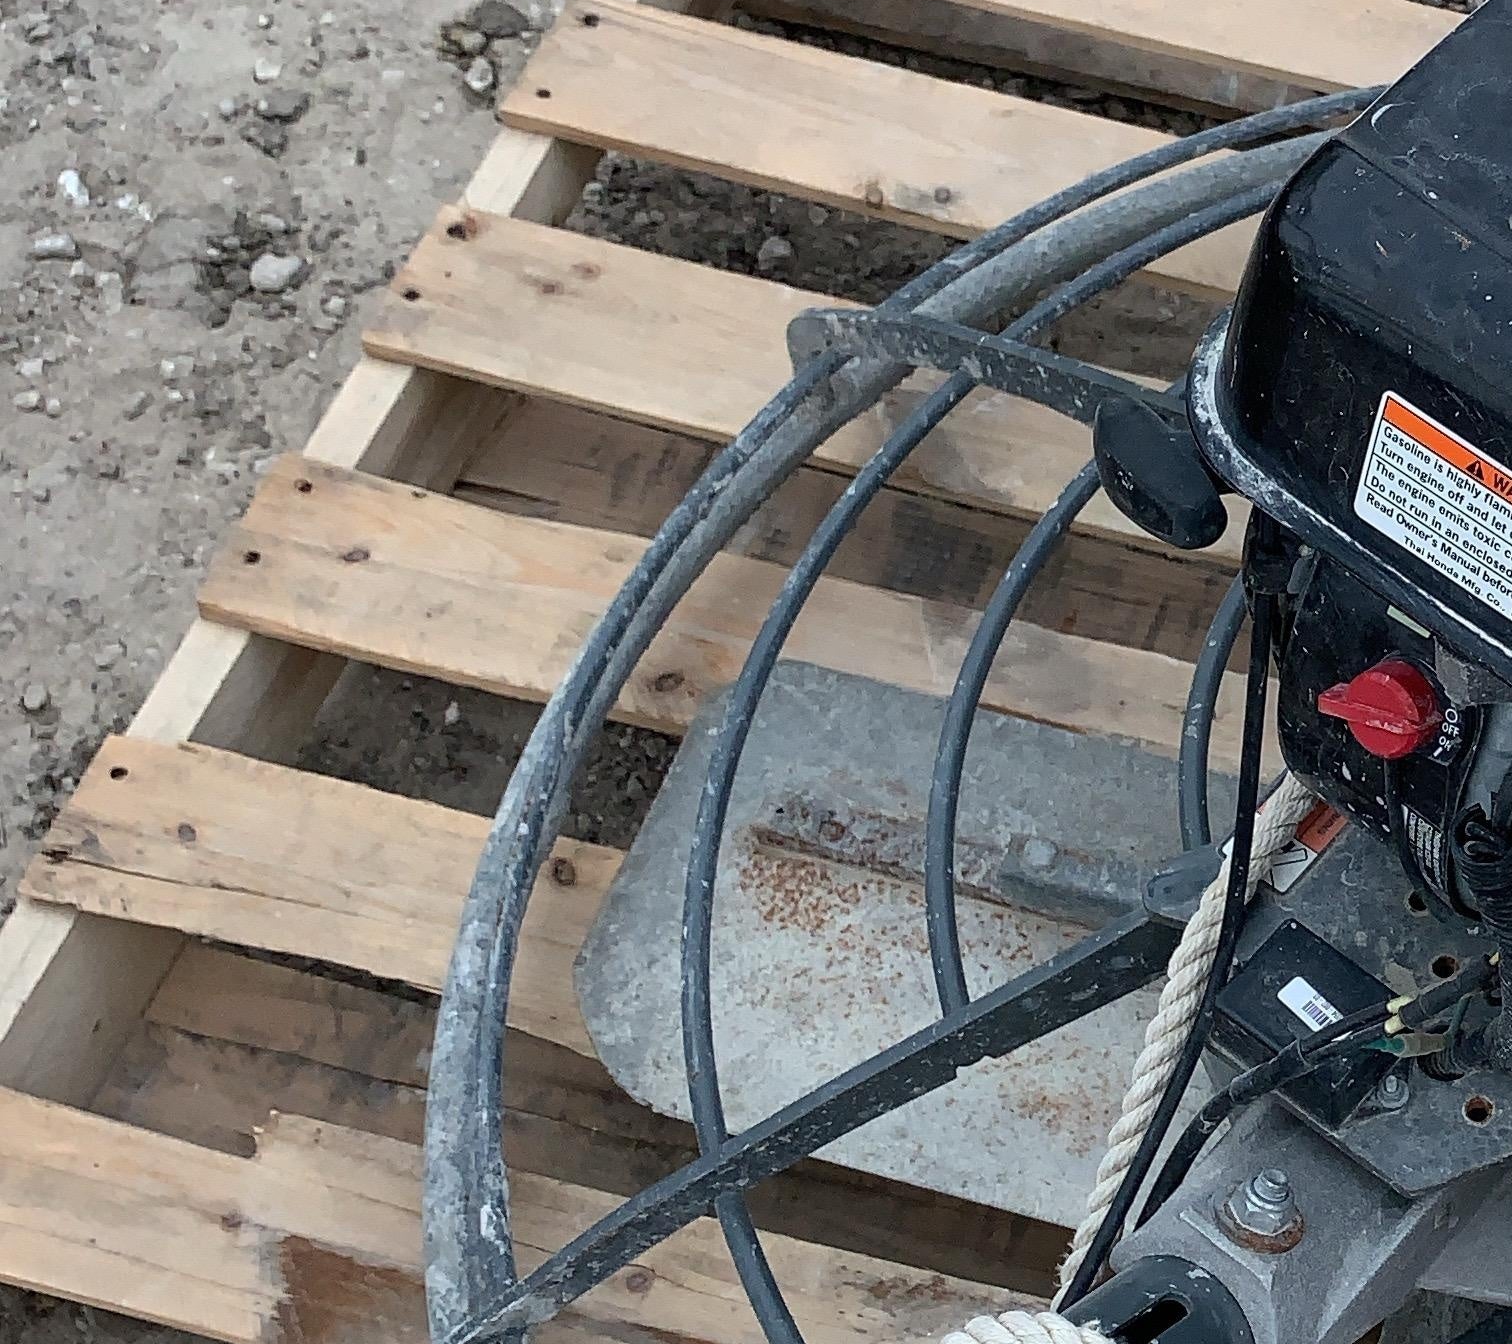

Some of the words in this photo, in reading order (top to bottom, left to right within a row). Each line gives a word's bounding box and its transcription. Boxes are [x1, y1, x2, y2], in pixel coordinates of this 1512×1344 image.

[1380, 439, 1404, 466] Turn
[1406, 462, 1445, 493] engine
[1447, 489, 1465, 505] off
[1465, 501, 1490, 522] and
[1490, 515, 1507, 534] let
[1383, 425, 1431, 465] Gasoline
[1433, 458, 1444, 473] is
[1445, 466, 1482, 499] highly
[1365, 491, 1394, 518] Read
[1395, 512, 1438, 548] Owner's
[1439, 541, 1481, 577] Manual
[1370, 474, 1386, 493] Do
[1388, 489, 1407, 508] not
[1408, 503, 1429, 522] run
[1430, 515, 1442, 531] in
[1444, 527, 1460, 543] an
[1375, 458, 1395, 481] The
[1397, 478, 1436, 509] engine
[1438, 505, 1470, 531] emits
[1472, 525, 1501, 552] toxic
[1403, 534, 1425, 556] Thai
[1426, 551, 1459, 579] Honda
[1485, 592, 1505, 612] Co.,
[1442, 722, 1460, 737] OFF
